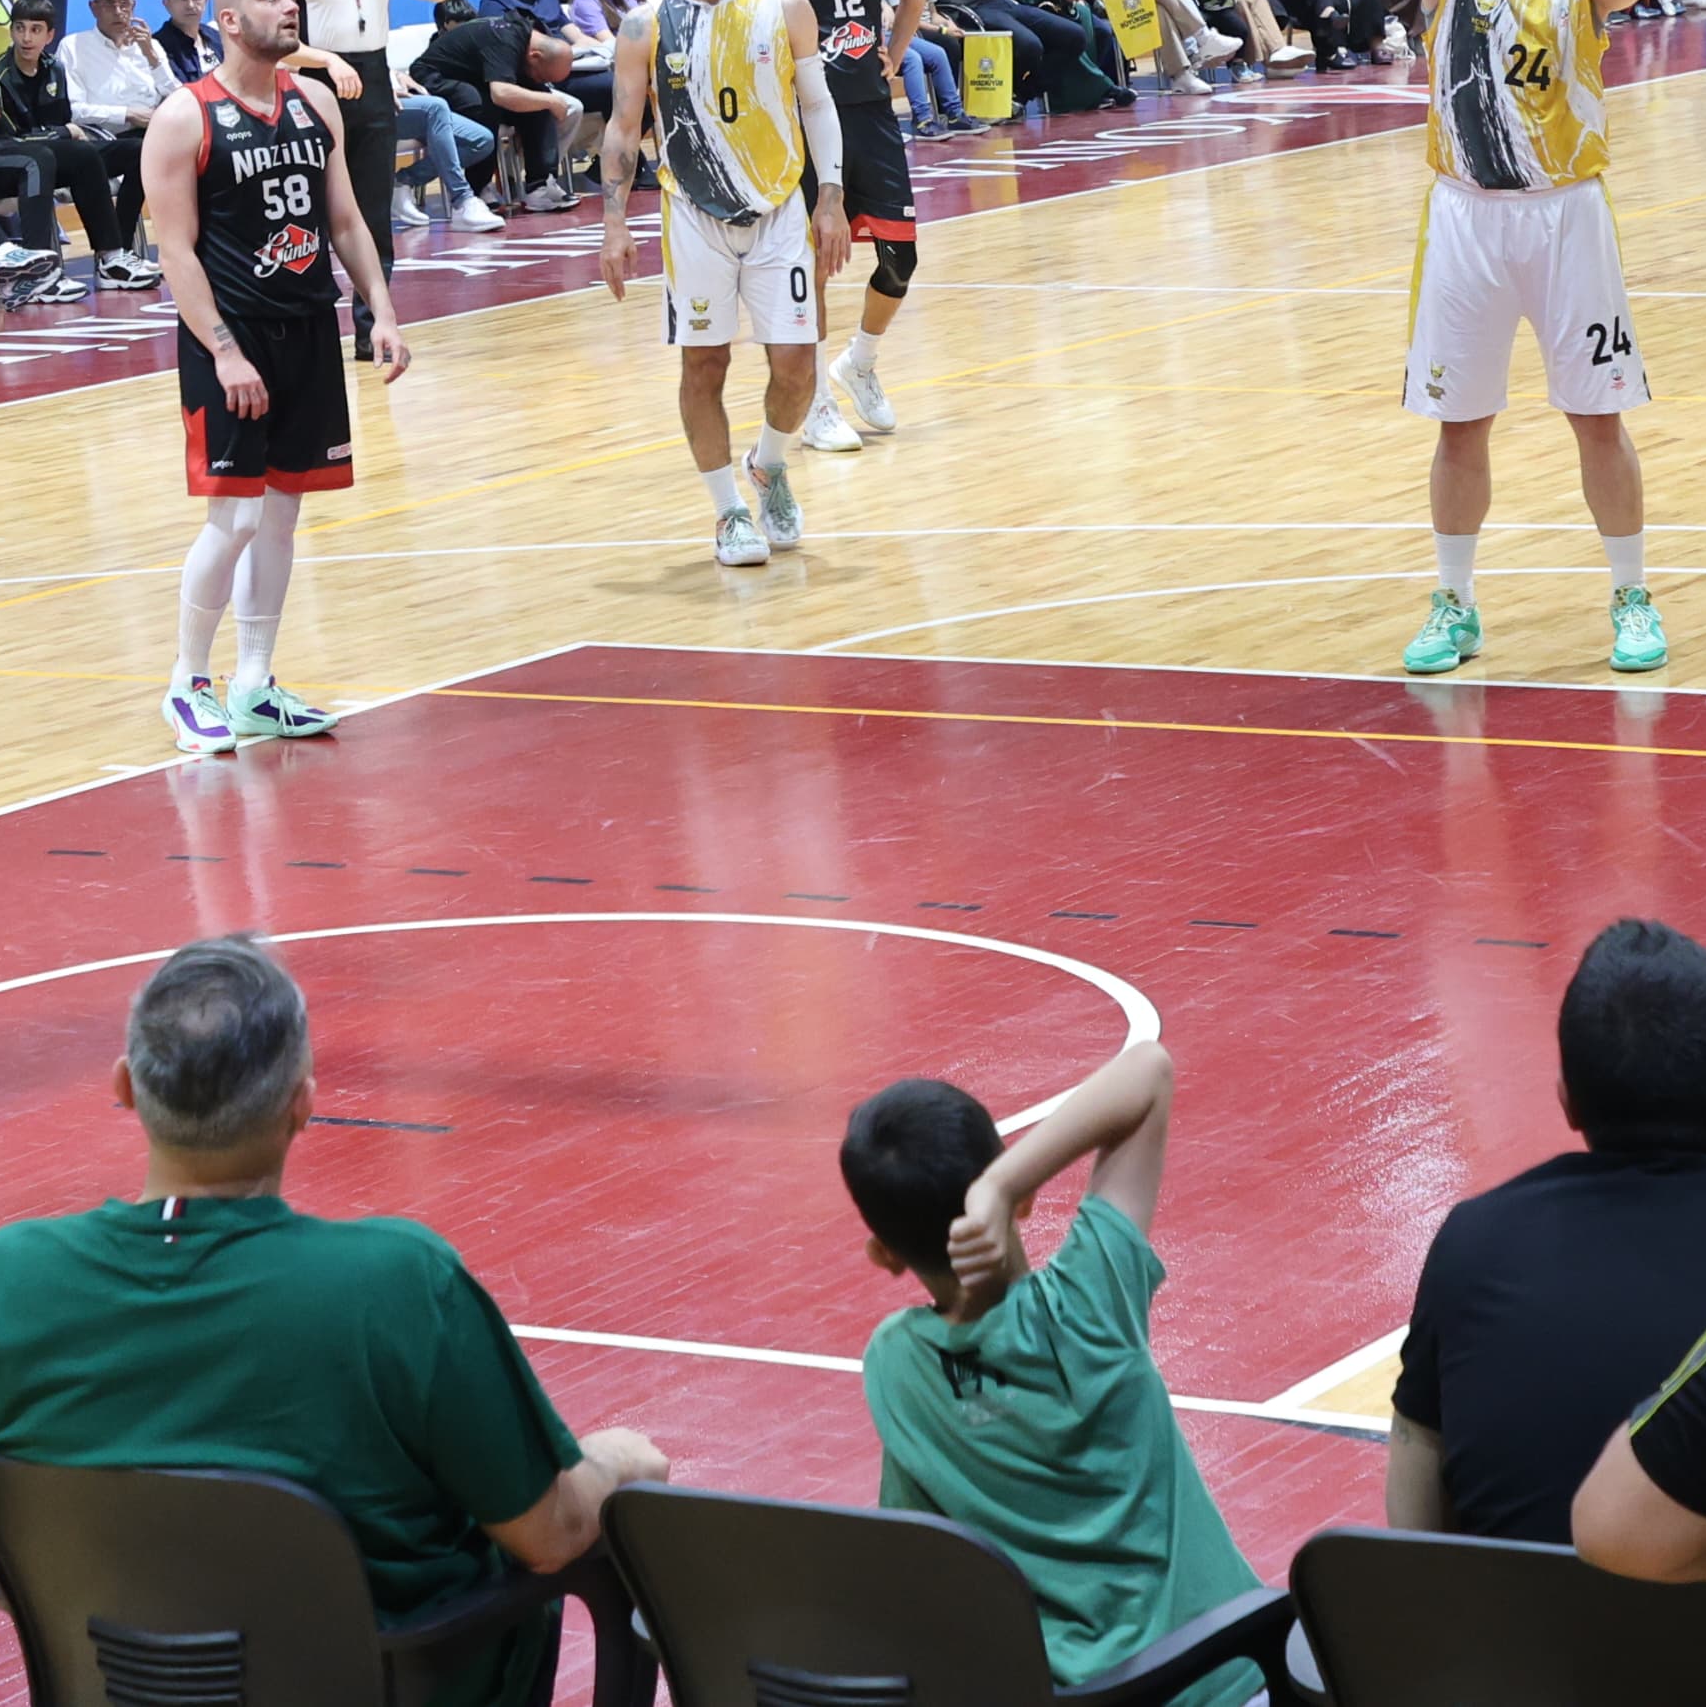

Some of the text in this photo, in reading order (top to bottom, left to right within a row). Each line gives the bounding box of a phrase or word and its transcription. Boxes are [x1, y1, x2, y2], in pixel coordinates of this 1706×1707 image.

[1504, 44, 1551, 91] 24
[719, 86, 738, 124] 0
[261, 174, 312, 220] 58
[789, 265, 807, 304] 0
[1586, 315, 1632, 367] 24
